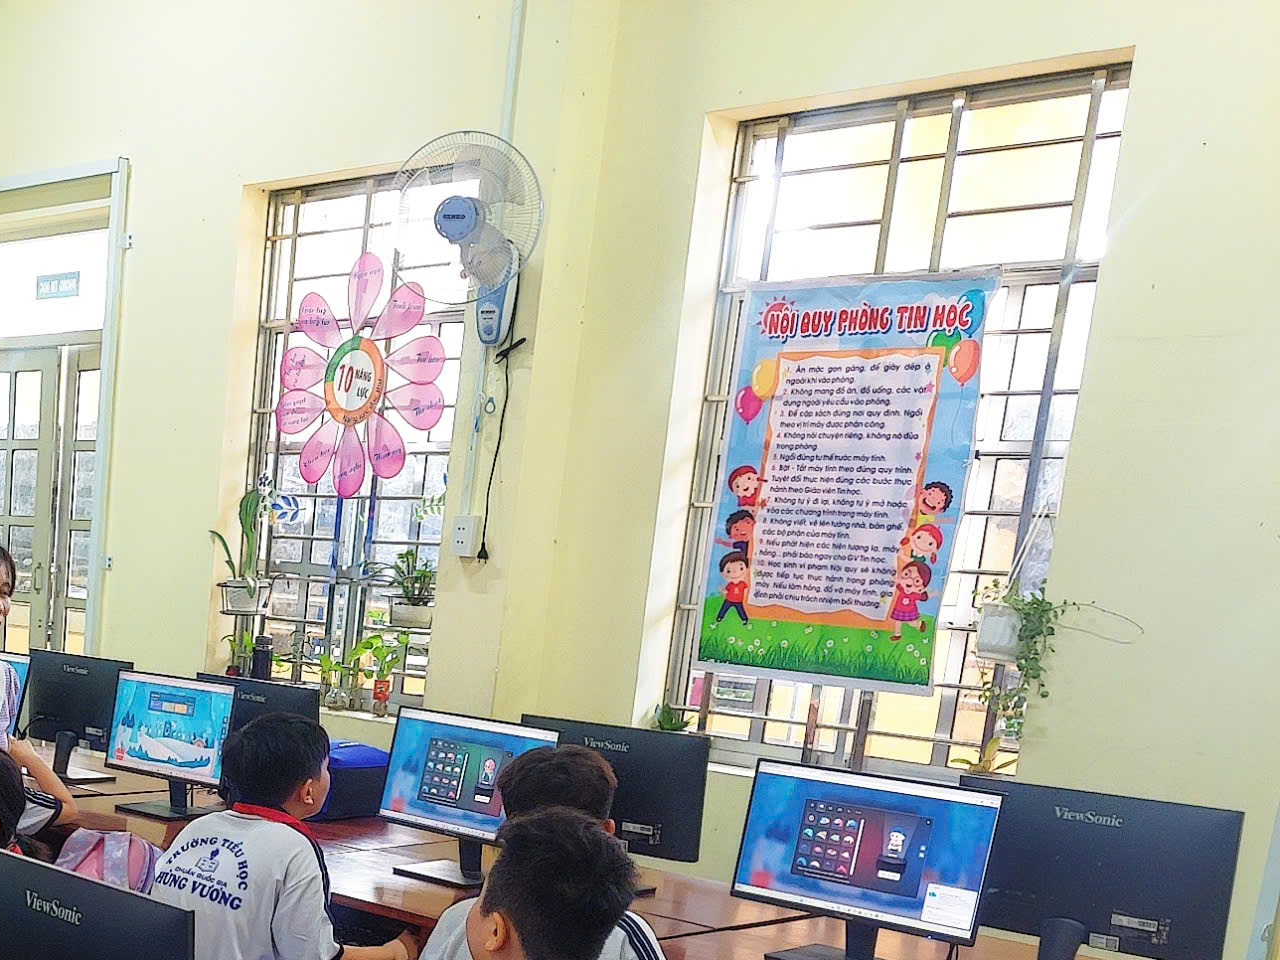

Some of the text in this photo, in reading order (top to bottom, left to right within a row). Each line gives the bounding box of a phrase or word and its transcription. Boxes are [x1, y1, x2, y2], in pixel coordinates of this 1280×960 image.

[768, 302, 973, 340] NỘI QUY PHÒNG TIN HỌC
[338, 365, 354, 393] 10
[584, 736, 630, 753] ViewSonic
[1054, 806, 1124, 828] ViewSonic
[166, 837, 249, 891] TRƯỜNG TIỂU HỌC
[25, 889, 82, 925] ViewSonic
[191, 881, 243, 911] VƯƠNG
